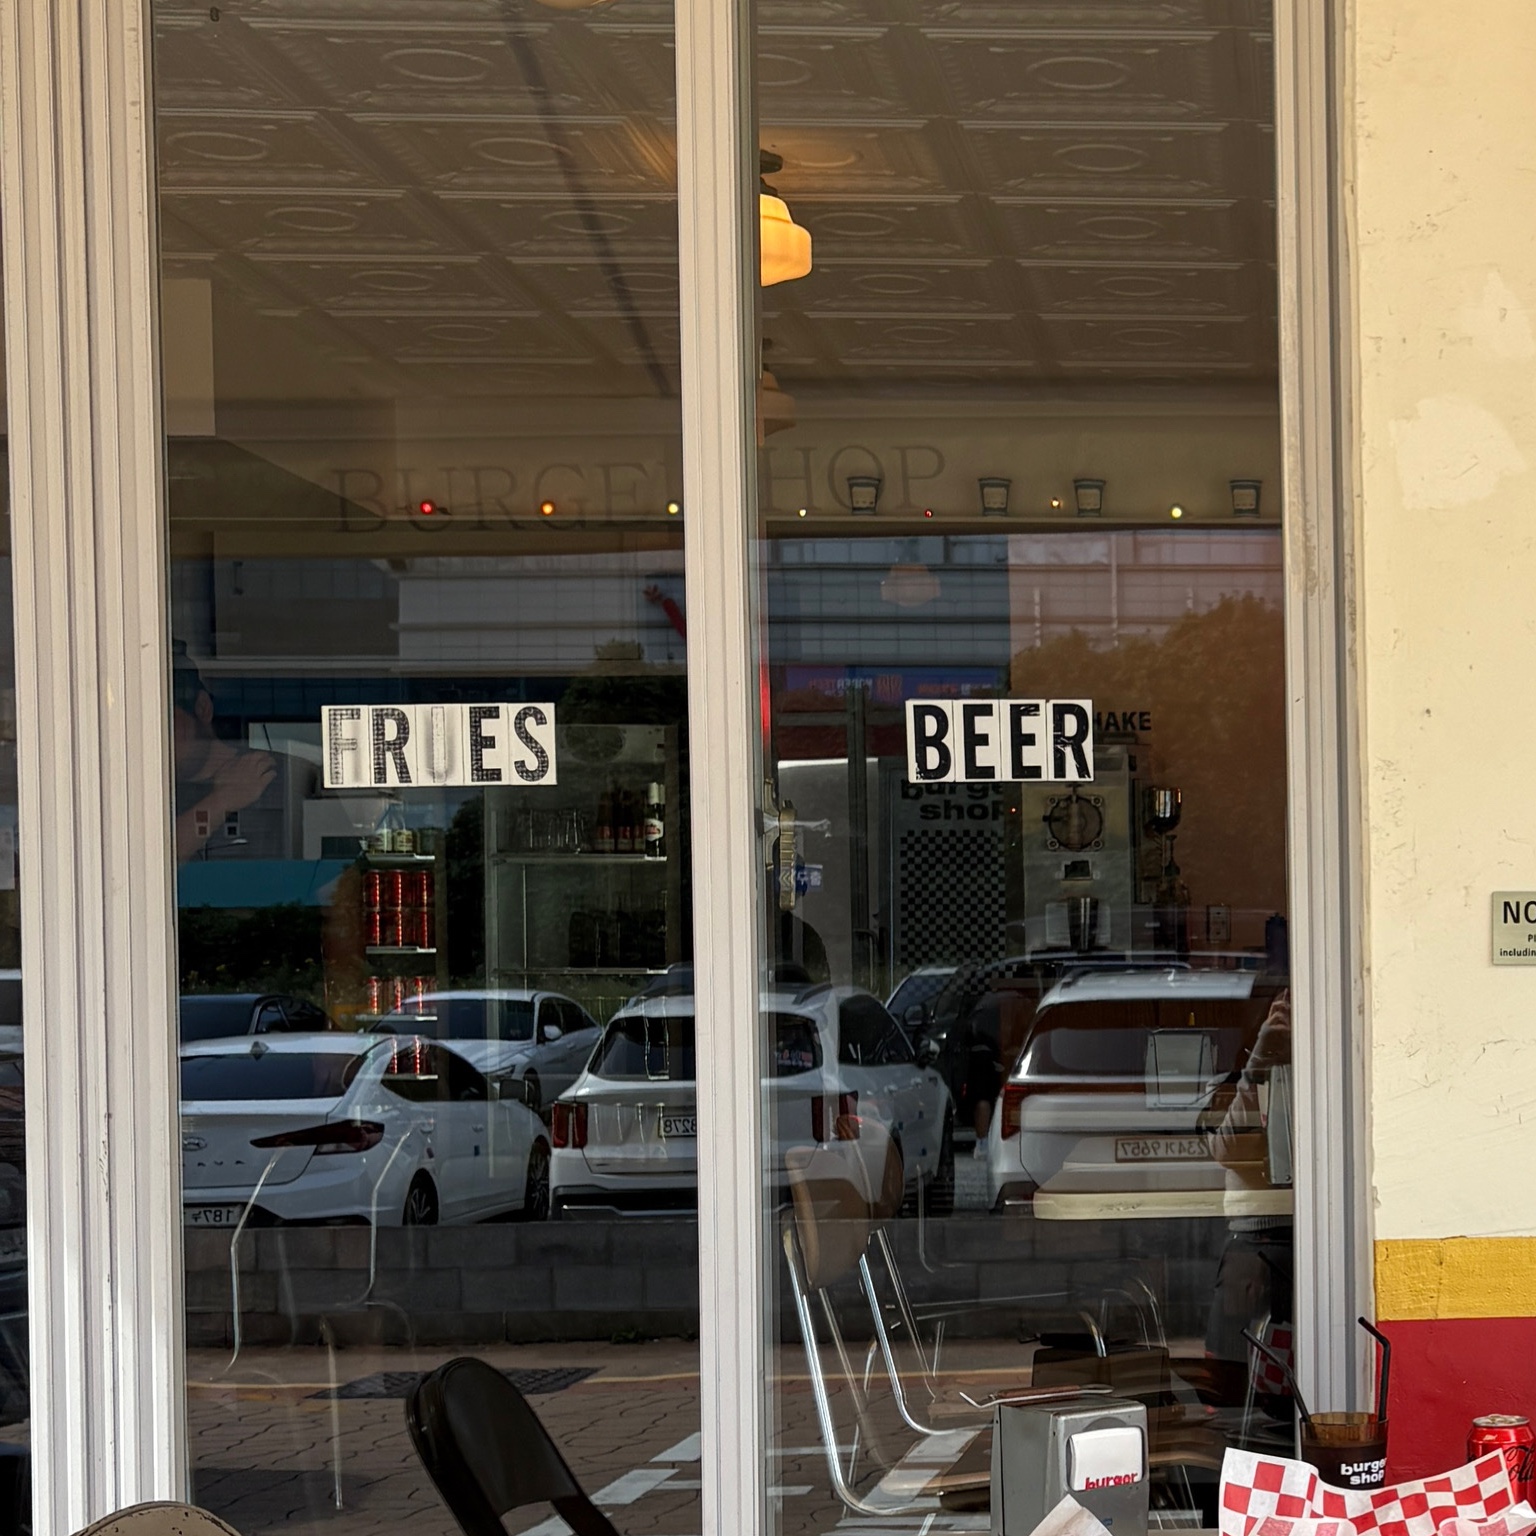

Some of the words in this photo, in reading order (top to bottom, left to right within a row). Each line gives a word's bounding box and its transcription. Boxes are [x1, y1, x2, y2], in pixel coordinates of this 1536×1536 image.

[335, 461, 682, 535] BURGE
[758, 444, 947, 517] HOP
[913, 703, 1091, 780] BEER
[1340, 1457, 1387, 1475] burge
[1085, 1472, 1138, 1491] burger
[1350, 1470, 1385, 1485] shop
